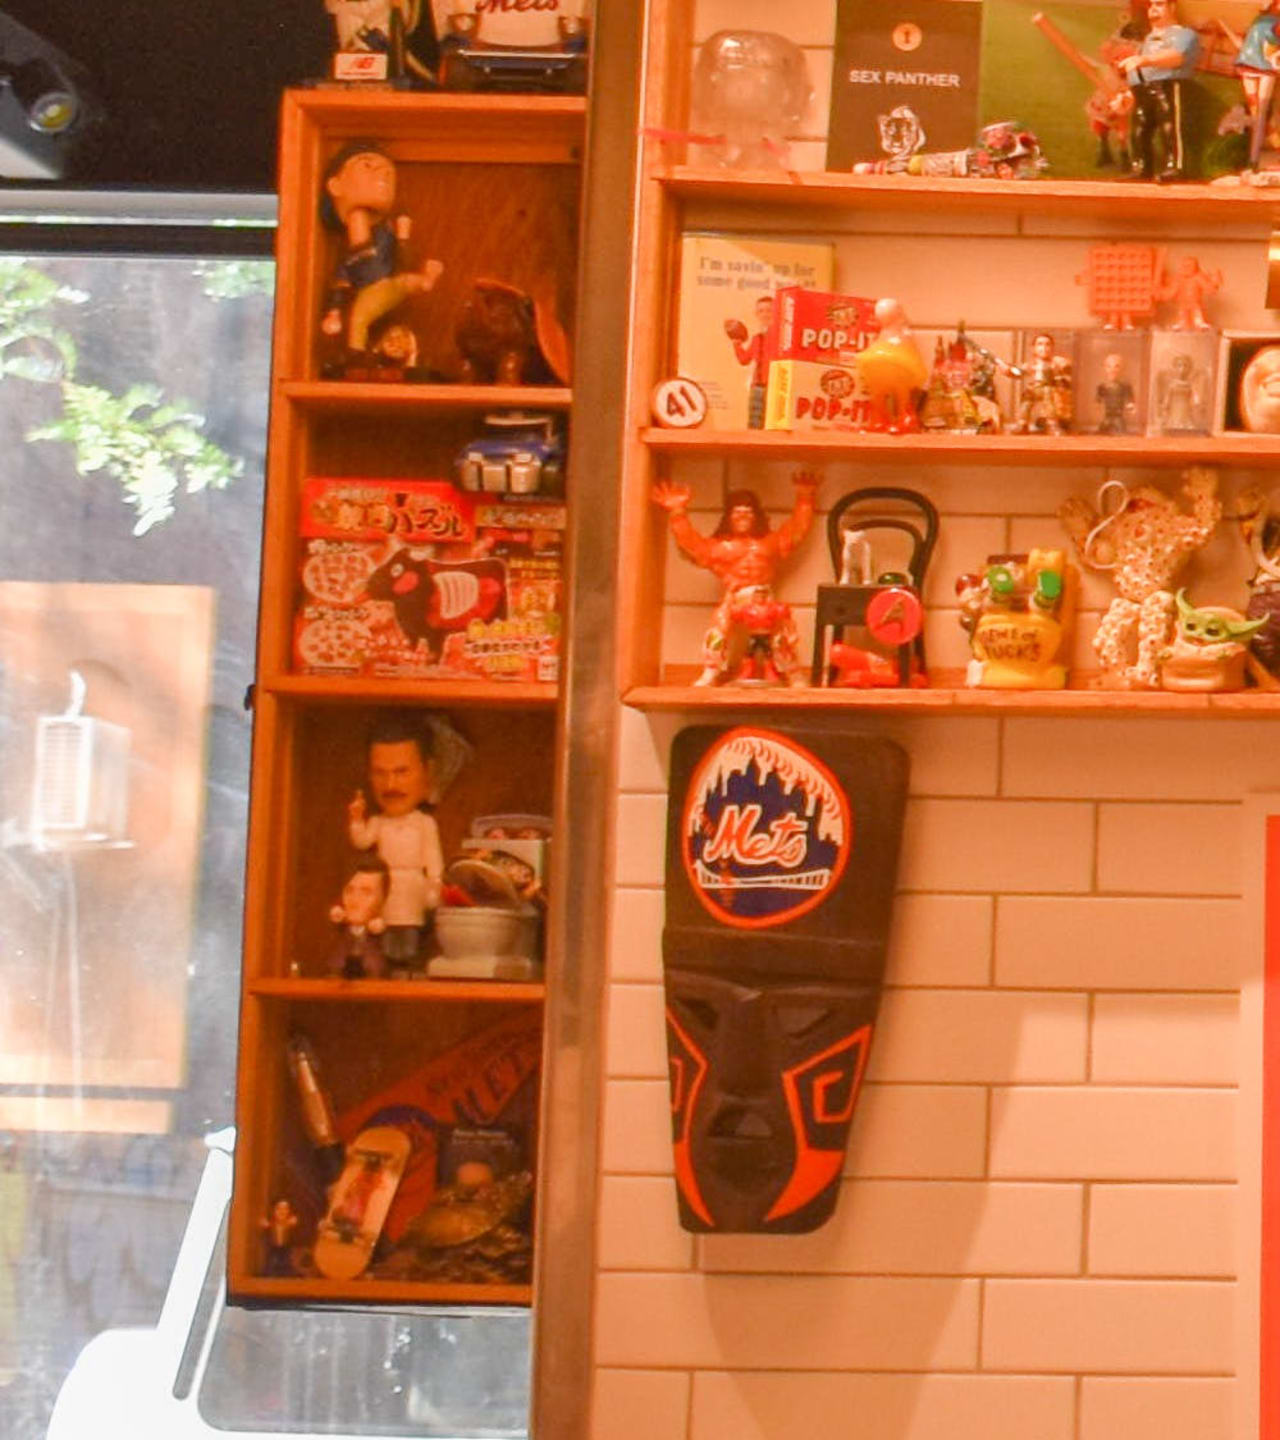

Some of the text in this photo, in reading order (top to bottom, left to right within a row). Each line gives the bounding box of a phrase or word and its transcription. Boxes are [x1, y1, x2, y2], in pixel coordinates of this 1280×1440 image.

[849, 69, 961, 88] SEX PANTHER
[666, 385, 698, 418] 41
[703, 804, 808, 868] Mets
